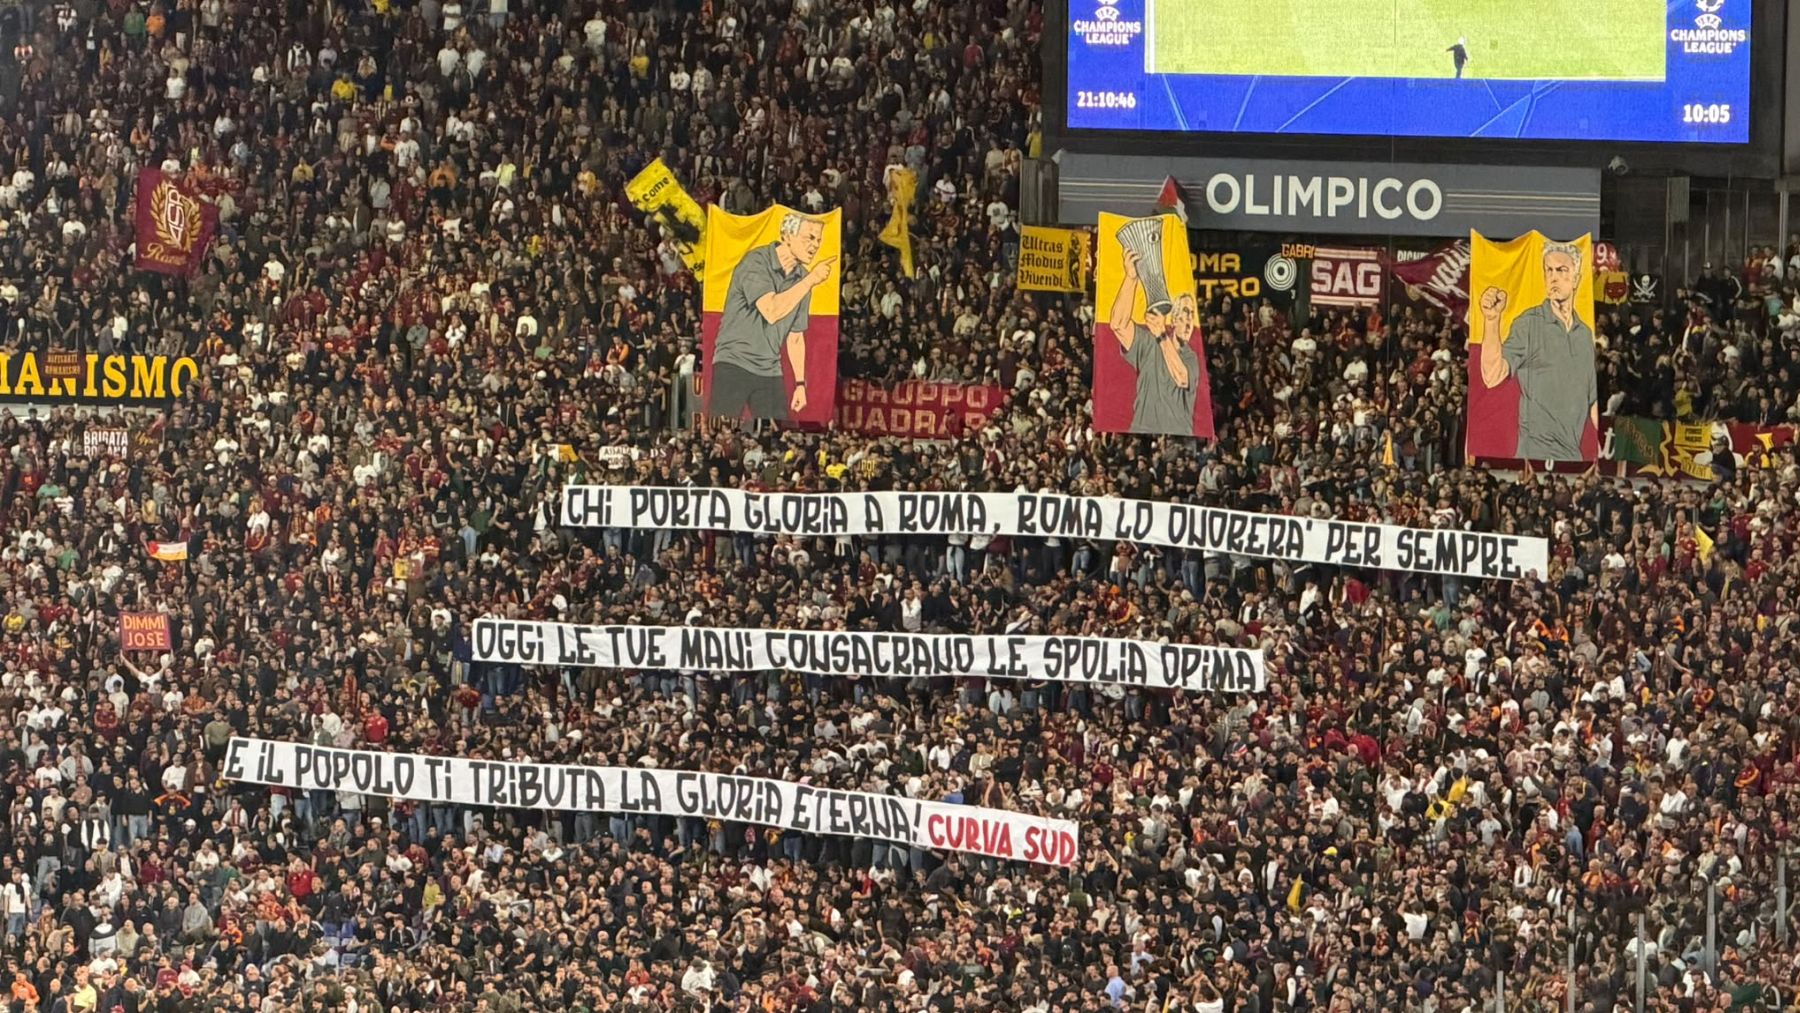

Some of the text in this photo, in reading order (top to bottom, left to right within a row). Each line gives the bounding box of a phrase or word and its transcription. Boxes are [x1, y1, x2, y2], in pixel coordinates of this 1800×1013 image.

[1074, 20, 1141, 33] CHAMPIONS
[1671, 29, 1746, 42] CHAMPIONS
[1077, 91, 1136, 108] 21:10:46
[1683, 104, 1730, 123] 10:05
[1206, 173, 1443, 221] OLIMPICO
[1022, 235, 1063, 254] Ultras
[1020, 254, 1064, 275] Modus
[1018, 270, 1063, 289] Vivendi
[1311, 259, 1381, 295] SAG
[84, 430, 128, 446] BRIGATA
[630, 488, 731, 529] PORTA
[865, 494, 884, 532] A
[898, 494, 1000, 533] ROMA,
[1018, 494, 1102, 537] ROMA
[1115, 501, 1153, 540] LO
[1325, 522, 1381, 567] PER
[122, 615, 165, 630] DIMMI
[558, 625, 596, 664] LE
[605, 627, 666, 667] TUE
[766, 632, 975, 675] CONSACRANO
[987, 638, 1028, 677] LE
[225, 740, 249, 779] E
[295, 745, 414, 795] POPOLO
[620, 770, 662, 812] LA
[791, 784, 922, 843] ETERNA!
[928, 813, 1013, 857] CURVA
[1023, 826, 1076, 865] SUD
